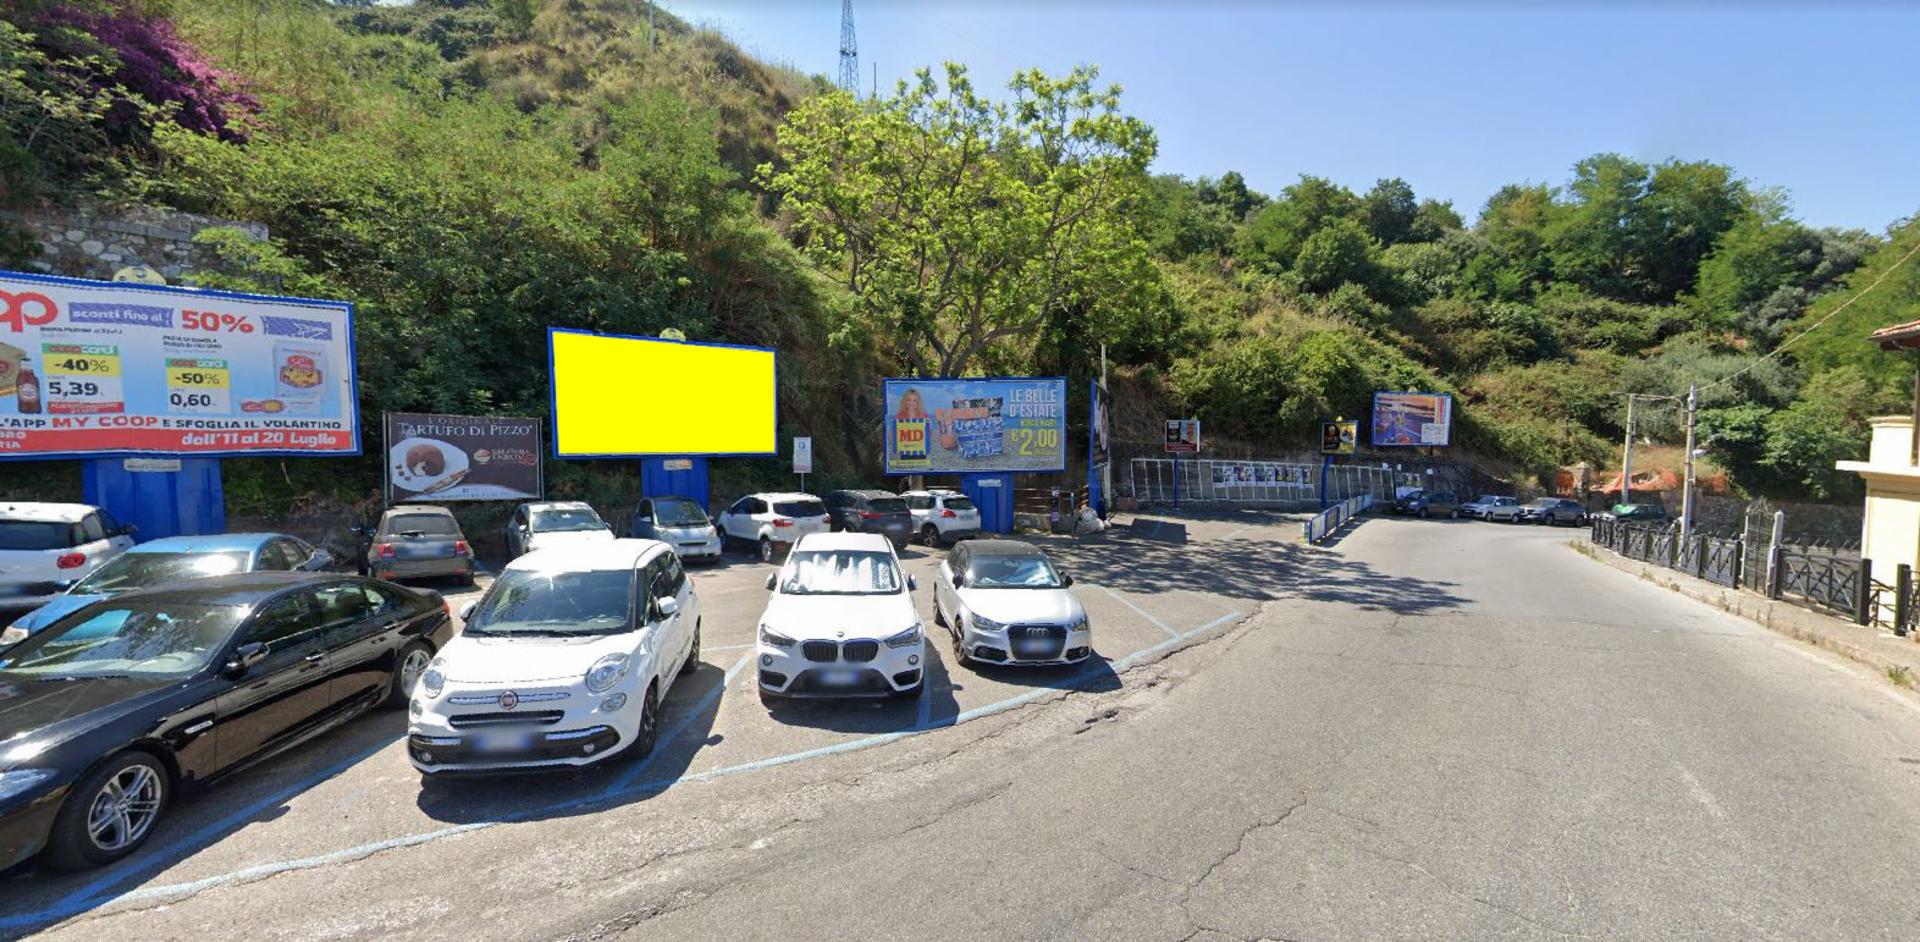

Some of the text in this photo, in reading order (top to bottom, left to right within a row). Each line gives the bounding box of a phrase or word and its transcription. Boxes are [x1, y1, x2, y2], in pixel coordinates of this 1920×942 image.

[72, 307, 163, 322] sconti fino al
[181, 309, 255, 333] 50%
[54, 358, 110, 373] -40%
[175, 373, 220, 385] -50%
[48, 382, 99, 397] 5,39
[1010, 388, 1057, 403] LE BELLE
[170, 393, 212, 407] 0,60
[1009, 403, 1057, 418] D'ESTATE
[52, 416, 88, 428] MY
[98, 415, 158, 427] COOP
[163, 419, 171, 427] E
[176, 419, 241, 429] SFOGLIA
[245, 419, 259, 429] IL
[264, 419, 341, 429] VOLANTINO
[397, 422, 465, 437] TARTUFO
[469, 425, 485, 436] DI
[241, 432, 259, 444] al
[263, 432, 283, 443] 20
[290, 432, 337, 447] Luglio
[899, 429, 924, 442] MD
